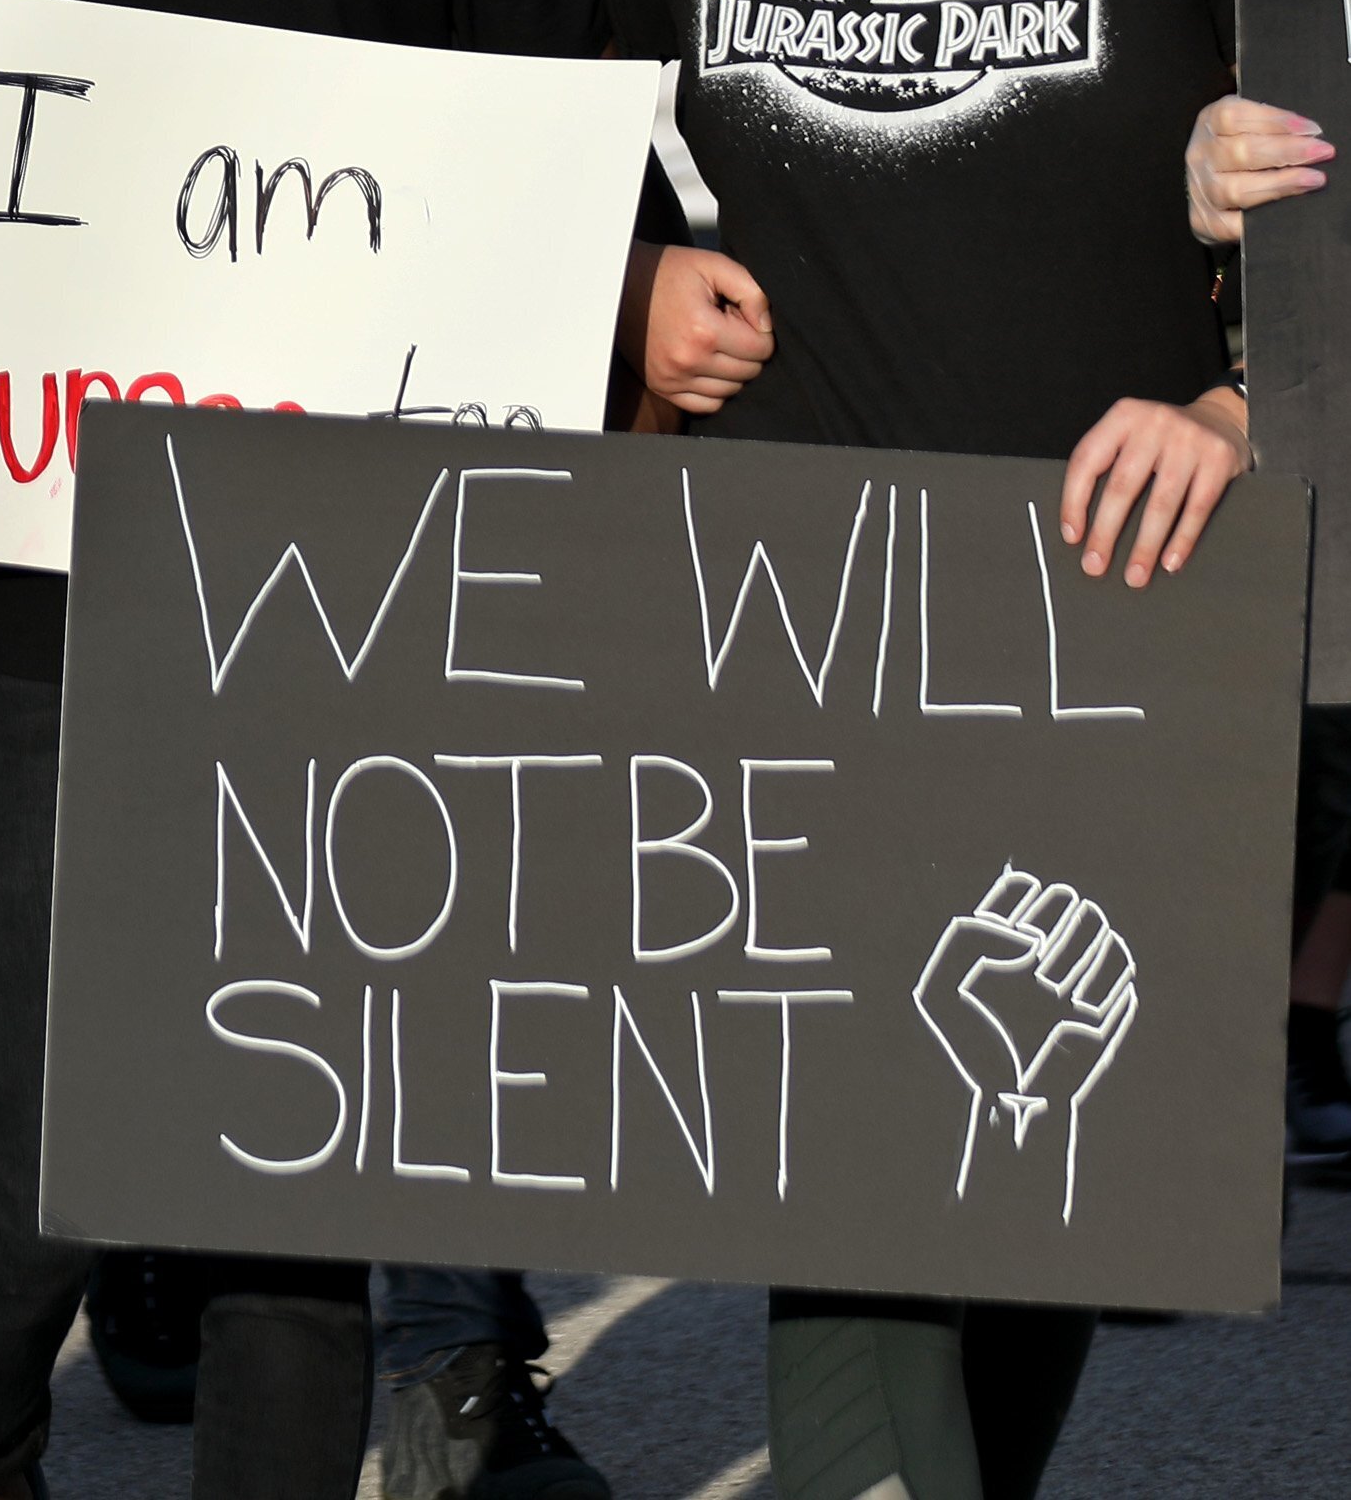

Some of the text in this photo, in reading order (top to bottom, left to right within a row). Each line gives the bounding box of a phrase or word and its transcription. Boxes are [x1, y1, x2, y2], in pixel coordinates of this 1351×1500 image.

[934, 0, 1082, 69] PARK
[176, 143, 382, 264] am
[165, 434, 1146, 721] WE WILL
[213, 753, 837, 962] NOT BE
[205, 977, 855, 1203] SILENT
